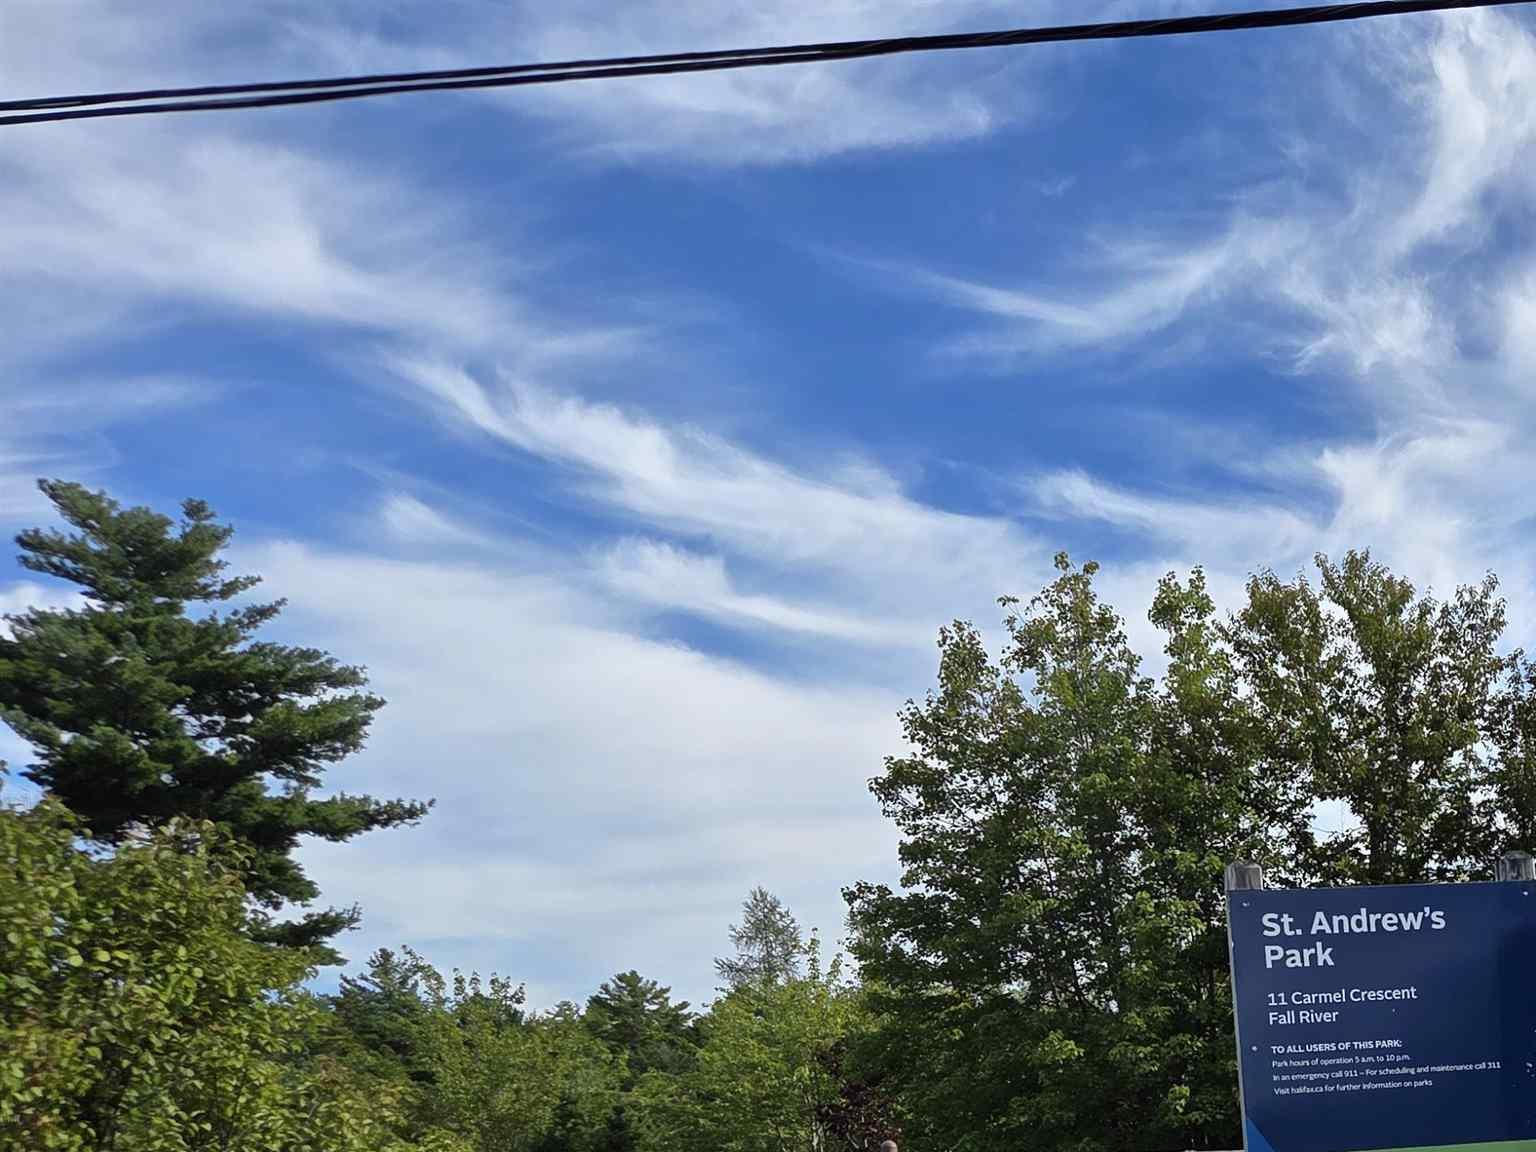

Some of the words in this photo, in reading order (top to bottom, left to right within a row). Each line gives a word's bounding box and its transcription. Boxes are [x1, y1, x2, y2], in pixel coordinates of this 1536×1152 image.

[1262, 912, 1302, 937] St.
[1310, 906, 1446, 935] Andrew's
[1264, 941, 1335, 969] Park
[1267, 992, 1288, 1006] 11
[1291, 988, 1346, 1005] Carmel
[1350, 986, 1418, 1002] Crescent
[1268, 1010, 1295, 1025] Fall
[1299, 1009, 1339, 1024] River
[1271, 1045, 1285, 1054] TO
[1286, 1044, 1305, 1053] ALL
[1305, 1043, 1337, 1052] USERS
[1337, 1041, 1352, 1051] OF
[1352, 1040, 1374, 1050] THIS
[1375, 1039, 1402, 1049] PARK:
[1272, 1060, 1288, 1068] Park
[1289, 1059, 1310, 1067] hours
[1310, 1058, 1319, 1066] of
[1319, 1057, 1354, 1066] operation
[1291, 1071, 1330, 1081] emergency
[1331, 1070, 1343, 1078] call
[1378, 1066, 1416, 1076] scheduling
[1416, 1065, 1429, 1073] and
[1430, 1063, 1474, 1073] maintenance
[1474, 1062, 1486, 1070] call
[1487, 1061, 1501, 1069] 311
[1274, 1087, 1290, 1095] Visit
[1324, 1084, 1335, 1092] for
[1336, 1082, 1361, 1092] further
[1362, 1079, 1402, 1090] information
[1413, 1079, 1433, 1088] parks
